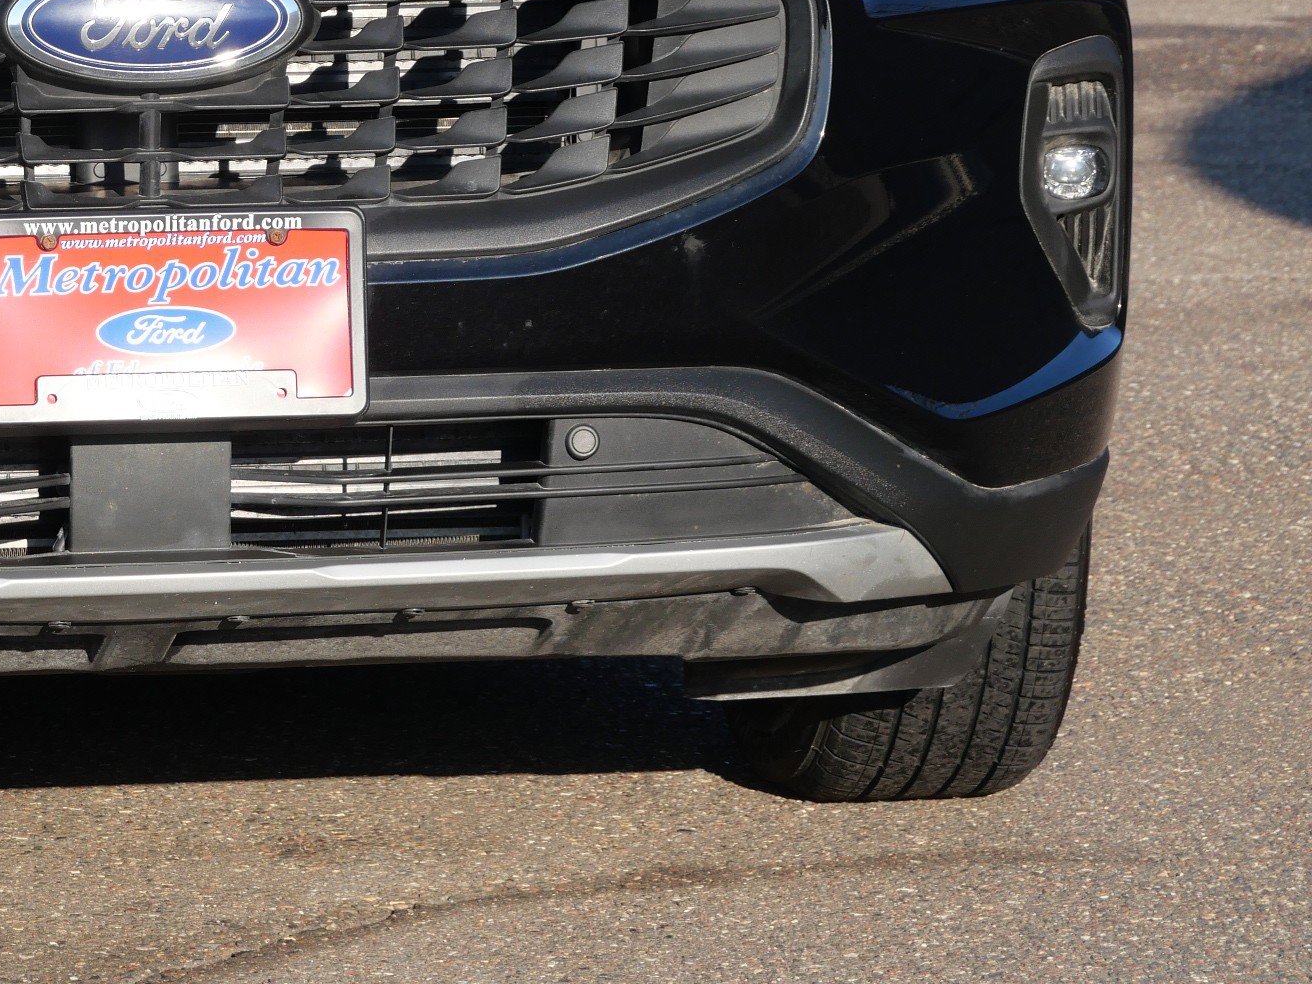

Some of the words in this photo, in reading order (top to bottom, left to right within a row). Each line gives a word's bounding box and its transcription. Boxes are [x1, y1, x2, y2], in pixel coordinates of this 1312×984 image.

[23, 214, 302, 236] www.metropolitanford.com
[60, 232, 267, 250] www.metropolitanford.com
[125, 314, 206, 345] Ford
